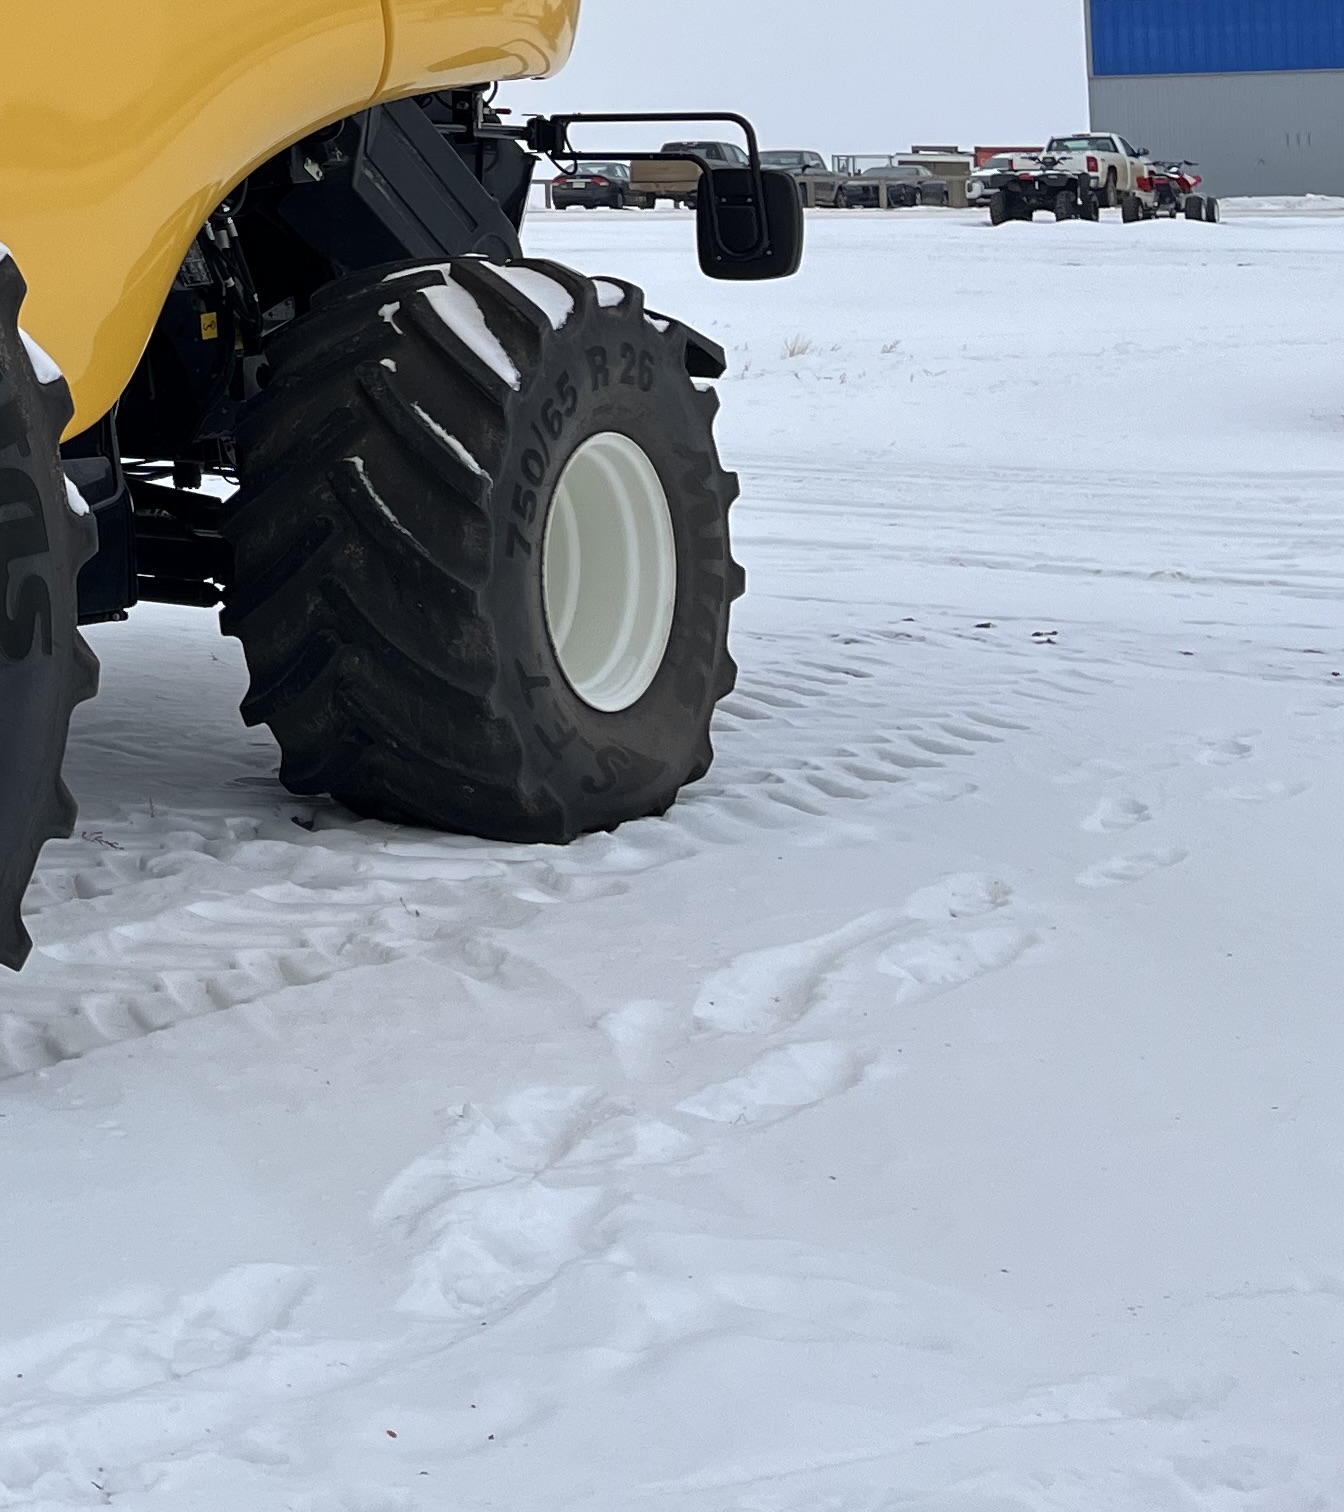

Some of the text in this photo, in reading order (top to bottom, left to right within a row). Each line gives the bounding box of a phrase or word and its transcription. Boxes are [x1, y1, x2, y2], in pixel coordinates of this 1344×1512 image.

[505, 341, 655, 559] 750/65 R 26
